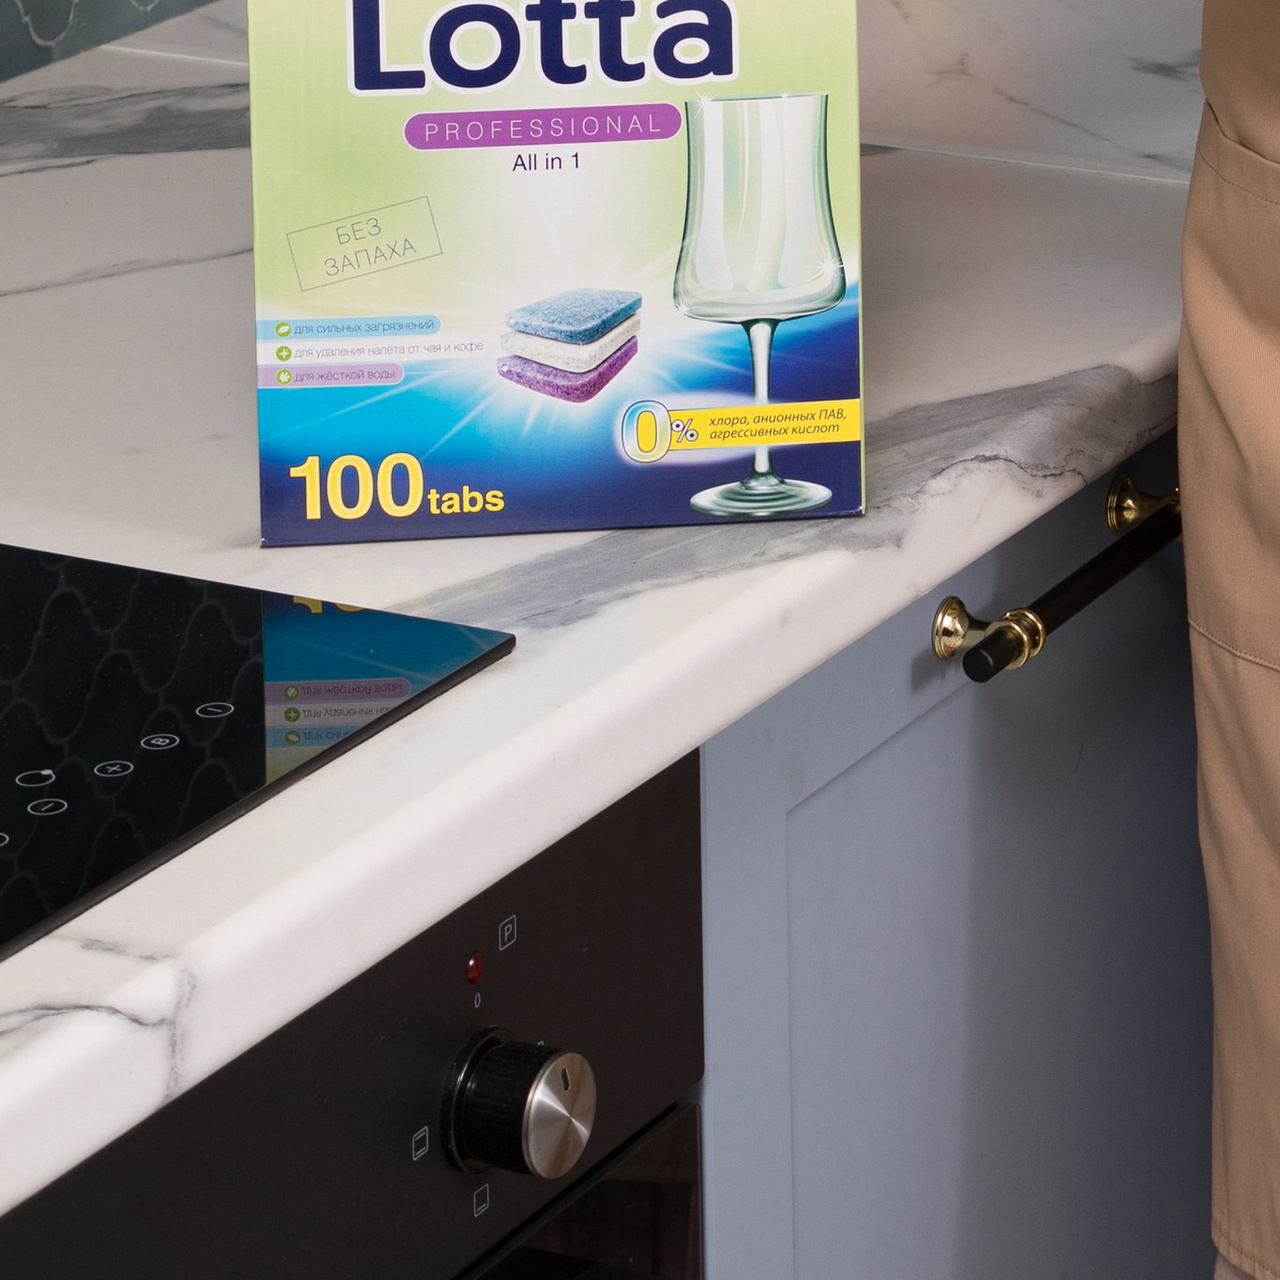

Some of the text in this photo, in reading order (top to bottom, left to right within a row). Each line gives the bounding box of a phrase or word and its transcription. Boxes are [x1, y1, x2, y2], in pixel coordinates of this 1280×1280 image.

[424, 114, 662, 142] PROFESSIONAL
[512, 151, 580, 172] All in 1
[335, 217, 382, 245] БЕЗ
[323, 237, 417, 278] ЗАПАХА
[294, 319, 435, 335] для сильных загрязнений
[294, 341, 484, 359] для удаления налёта от чая и кофе
[294, 372, 314, 383] для
[368, 370, 396, 381] воды
[709, 408, 847, 428] хлора, анионных ПАВ,
[621, 399, 699, 464] 0%
[709, 423, 840, 441] агрессивных кислот
[288, 452, 505, 519] 100 tabs
